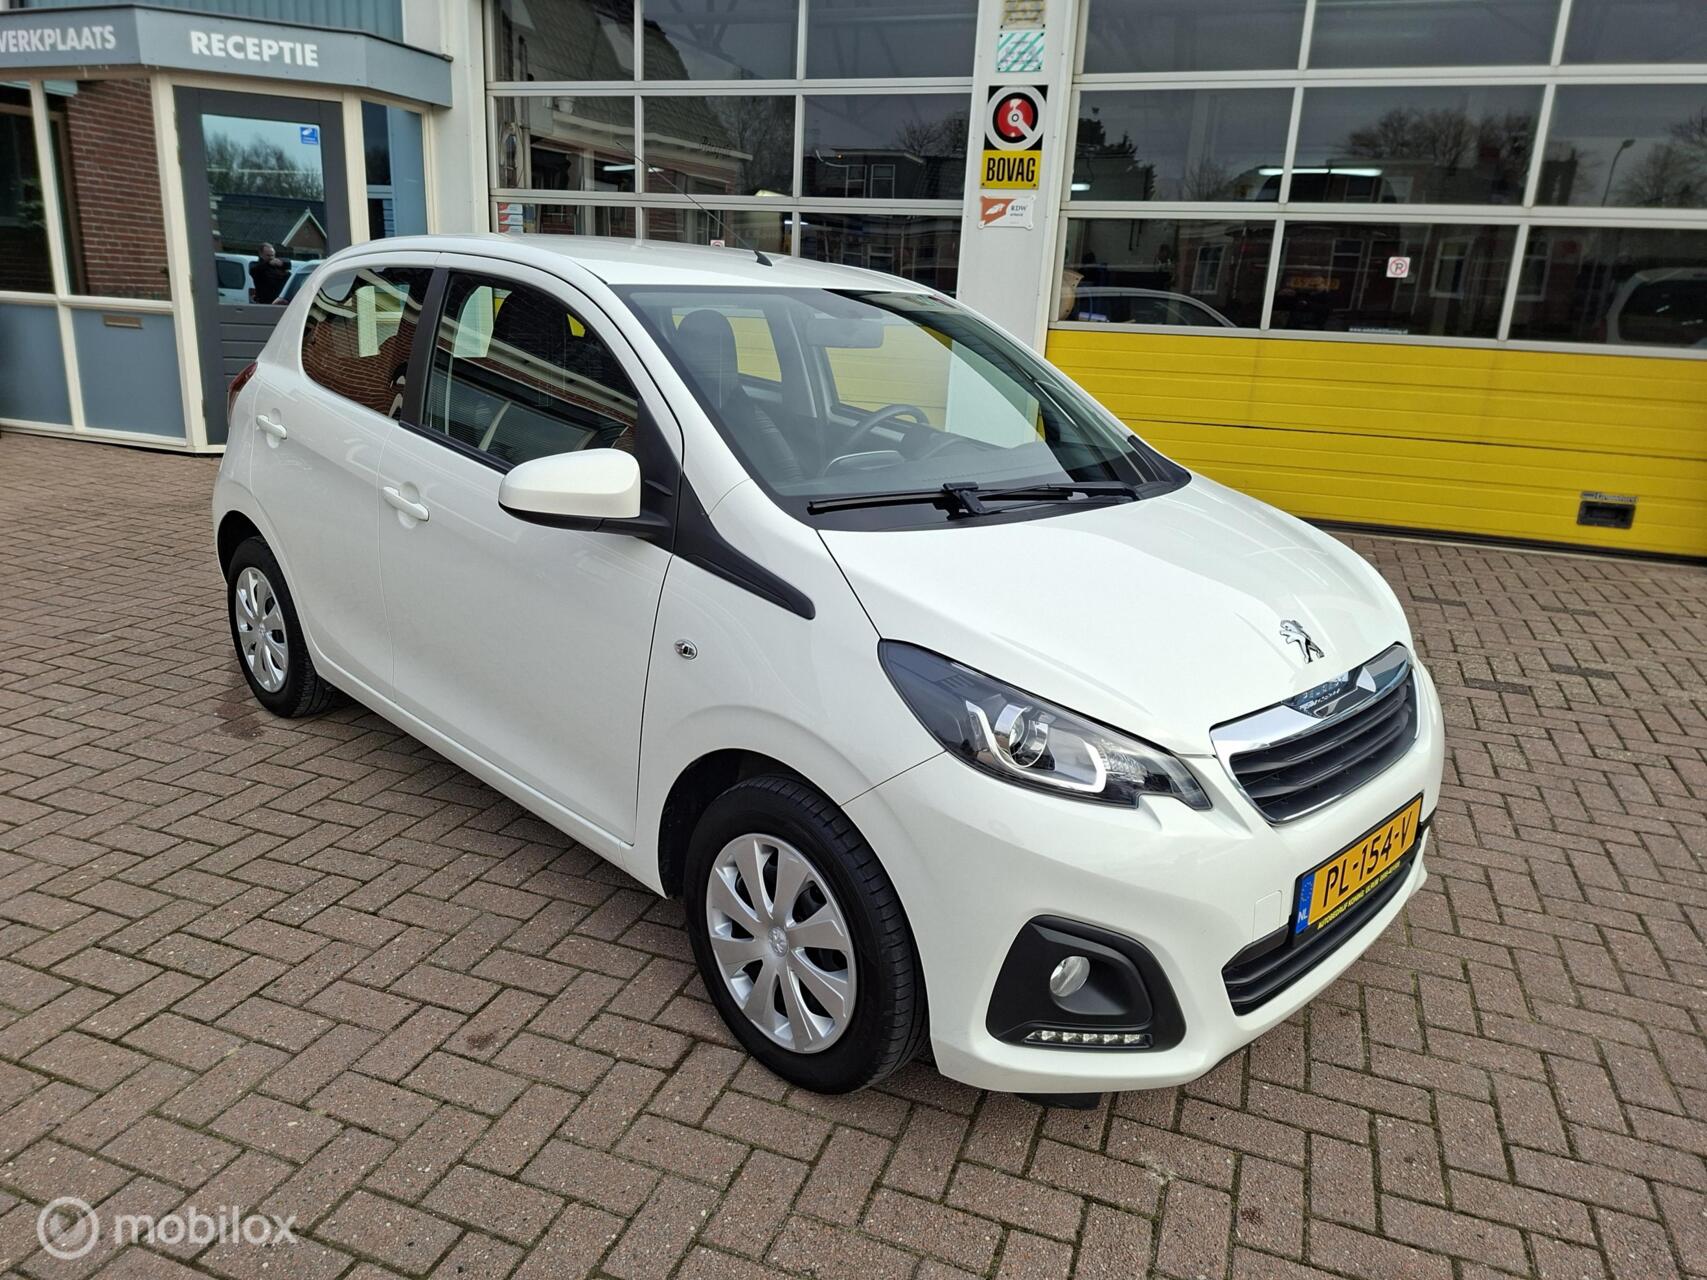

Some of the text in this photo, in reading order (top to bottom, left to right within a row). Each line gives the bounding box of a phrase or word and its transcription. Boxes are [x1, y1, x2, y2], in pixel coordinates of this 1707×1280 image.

[191, 31, 319, 67] RECEPTIE
[986, 158, 1036, 182] BOVAG
[1322, 810, 1412, 908] PL-154-V
[1298, 908, 1308, 925] NL
